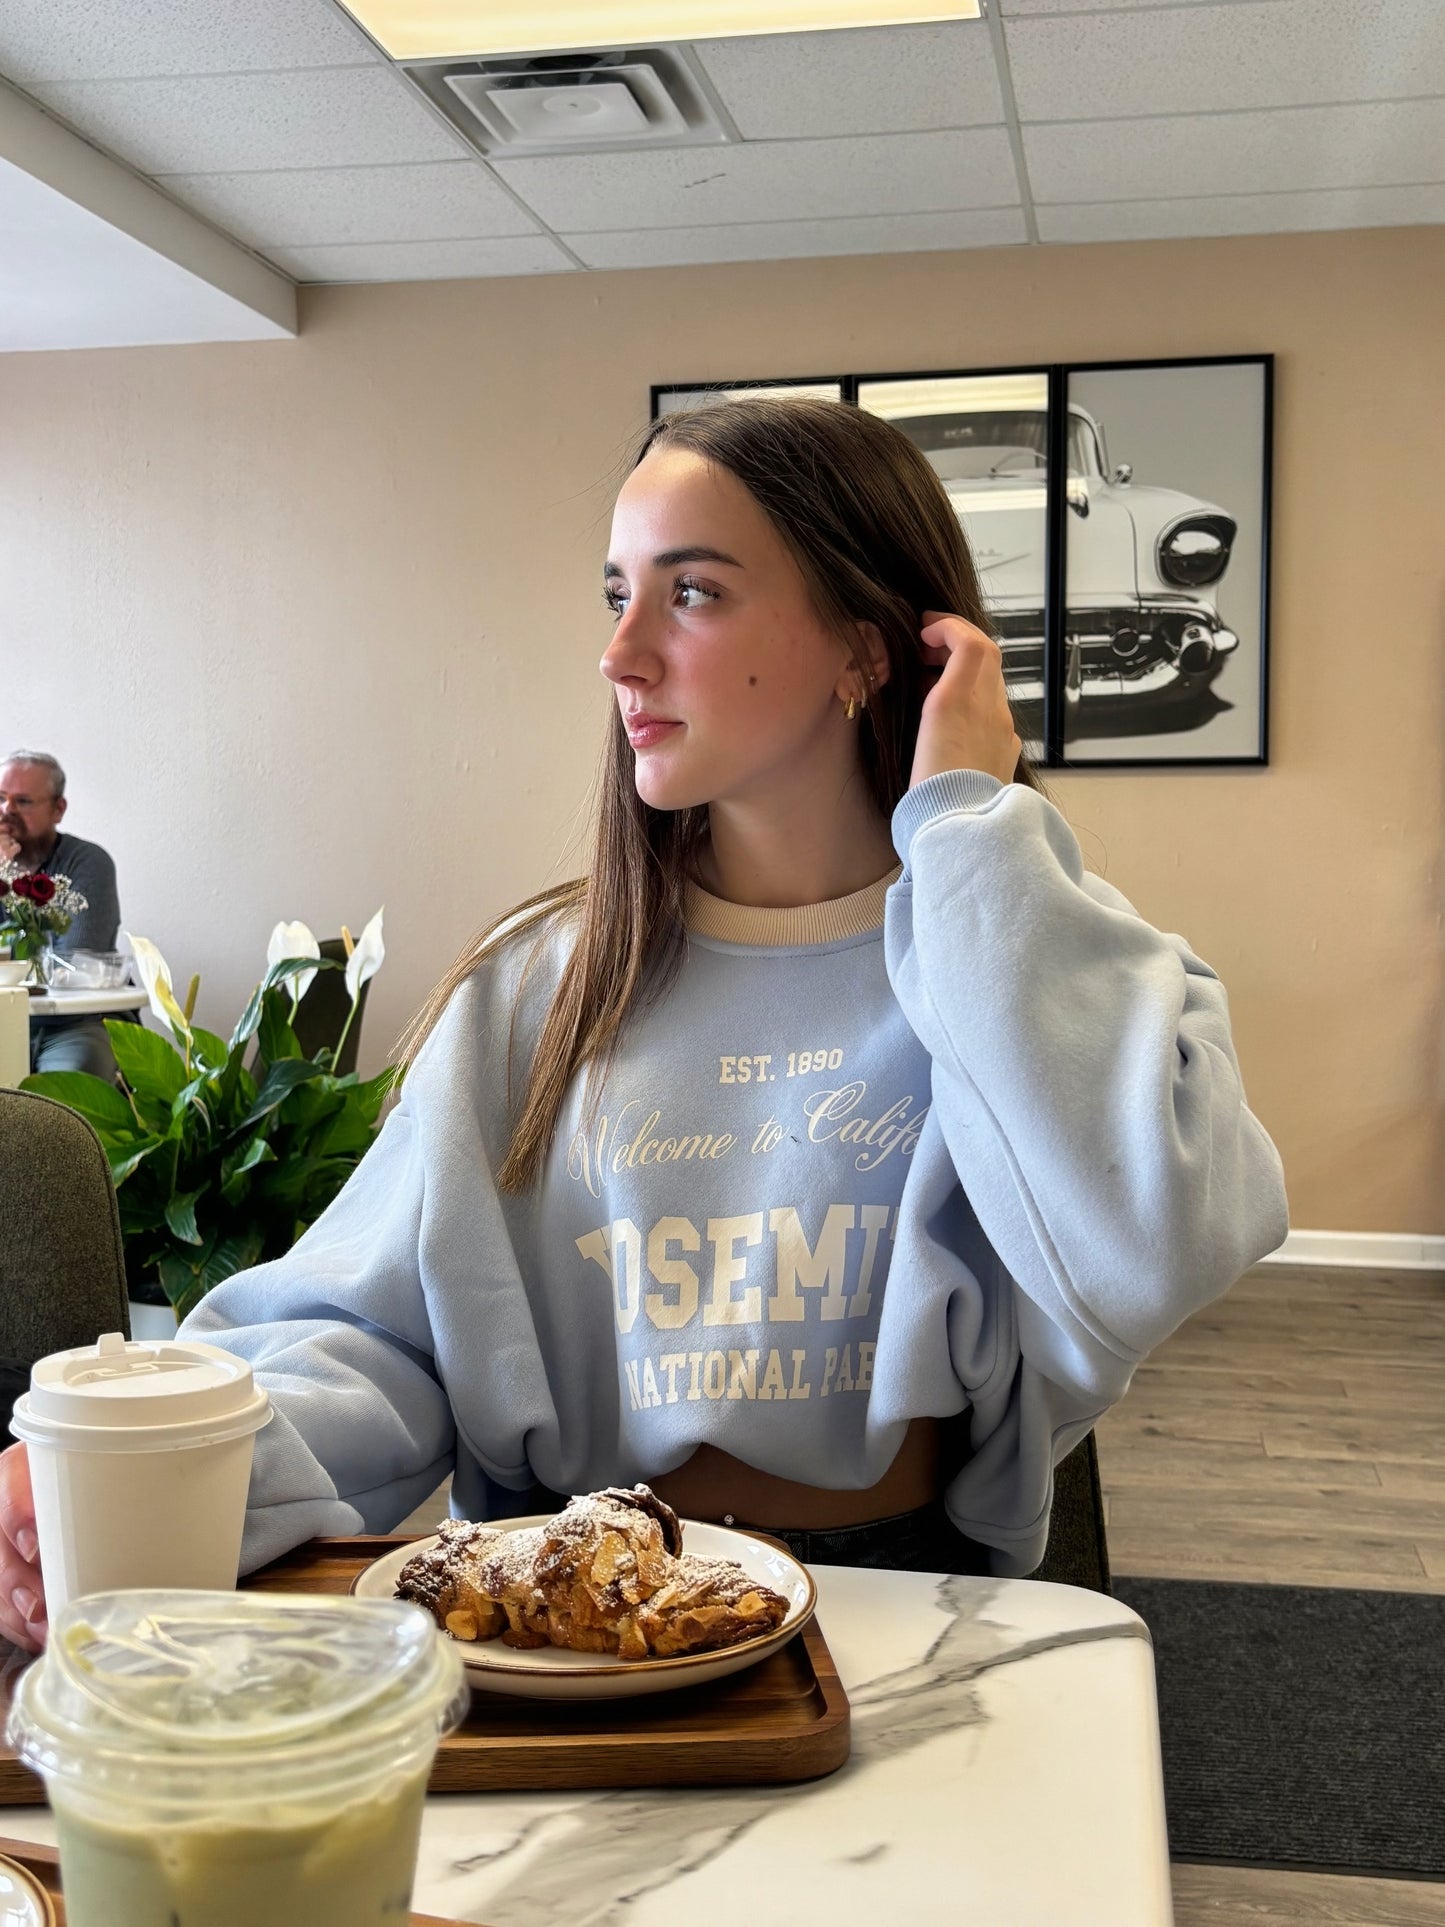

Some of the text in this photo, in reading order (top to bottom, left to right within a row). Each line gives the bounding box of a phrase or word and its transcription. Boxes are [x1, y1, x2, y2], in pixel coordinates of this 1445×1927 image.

[719, 1048, 843, 1084] EST. 1890
[567, 1100, 738, 1199] Welcome
[751, 1115, 790, 1154] to
[624, 1349, 811, 1411] NATIONAL
